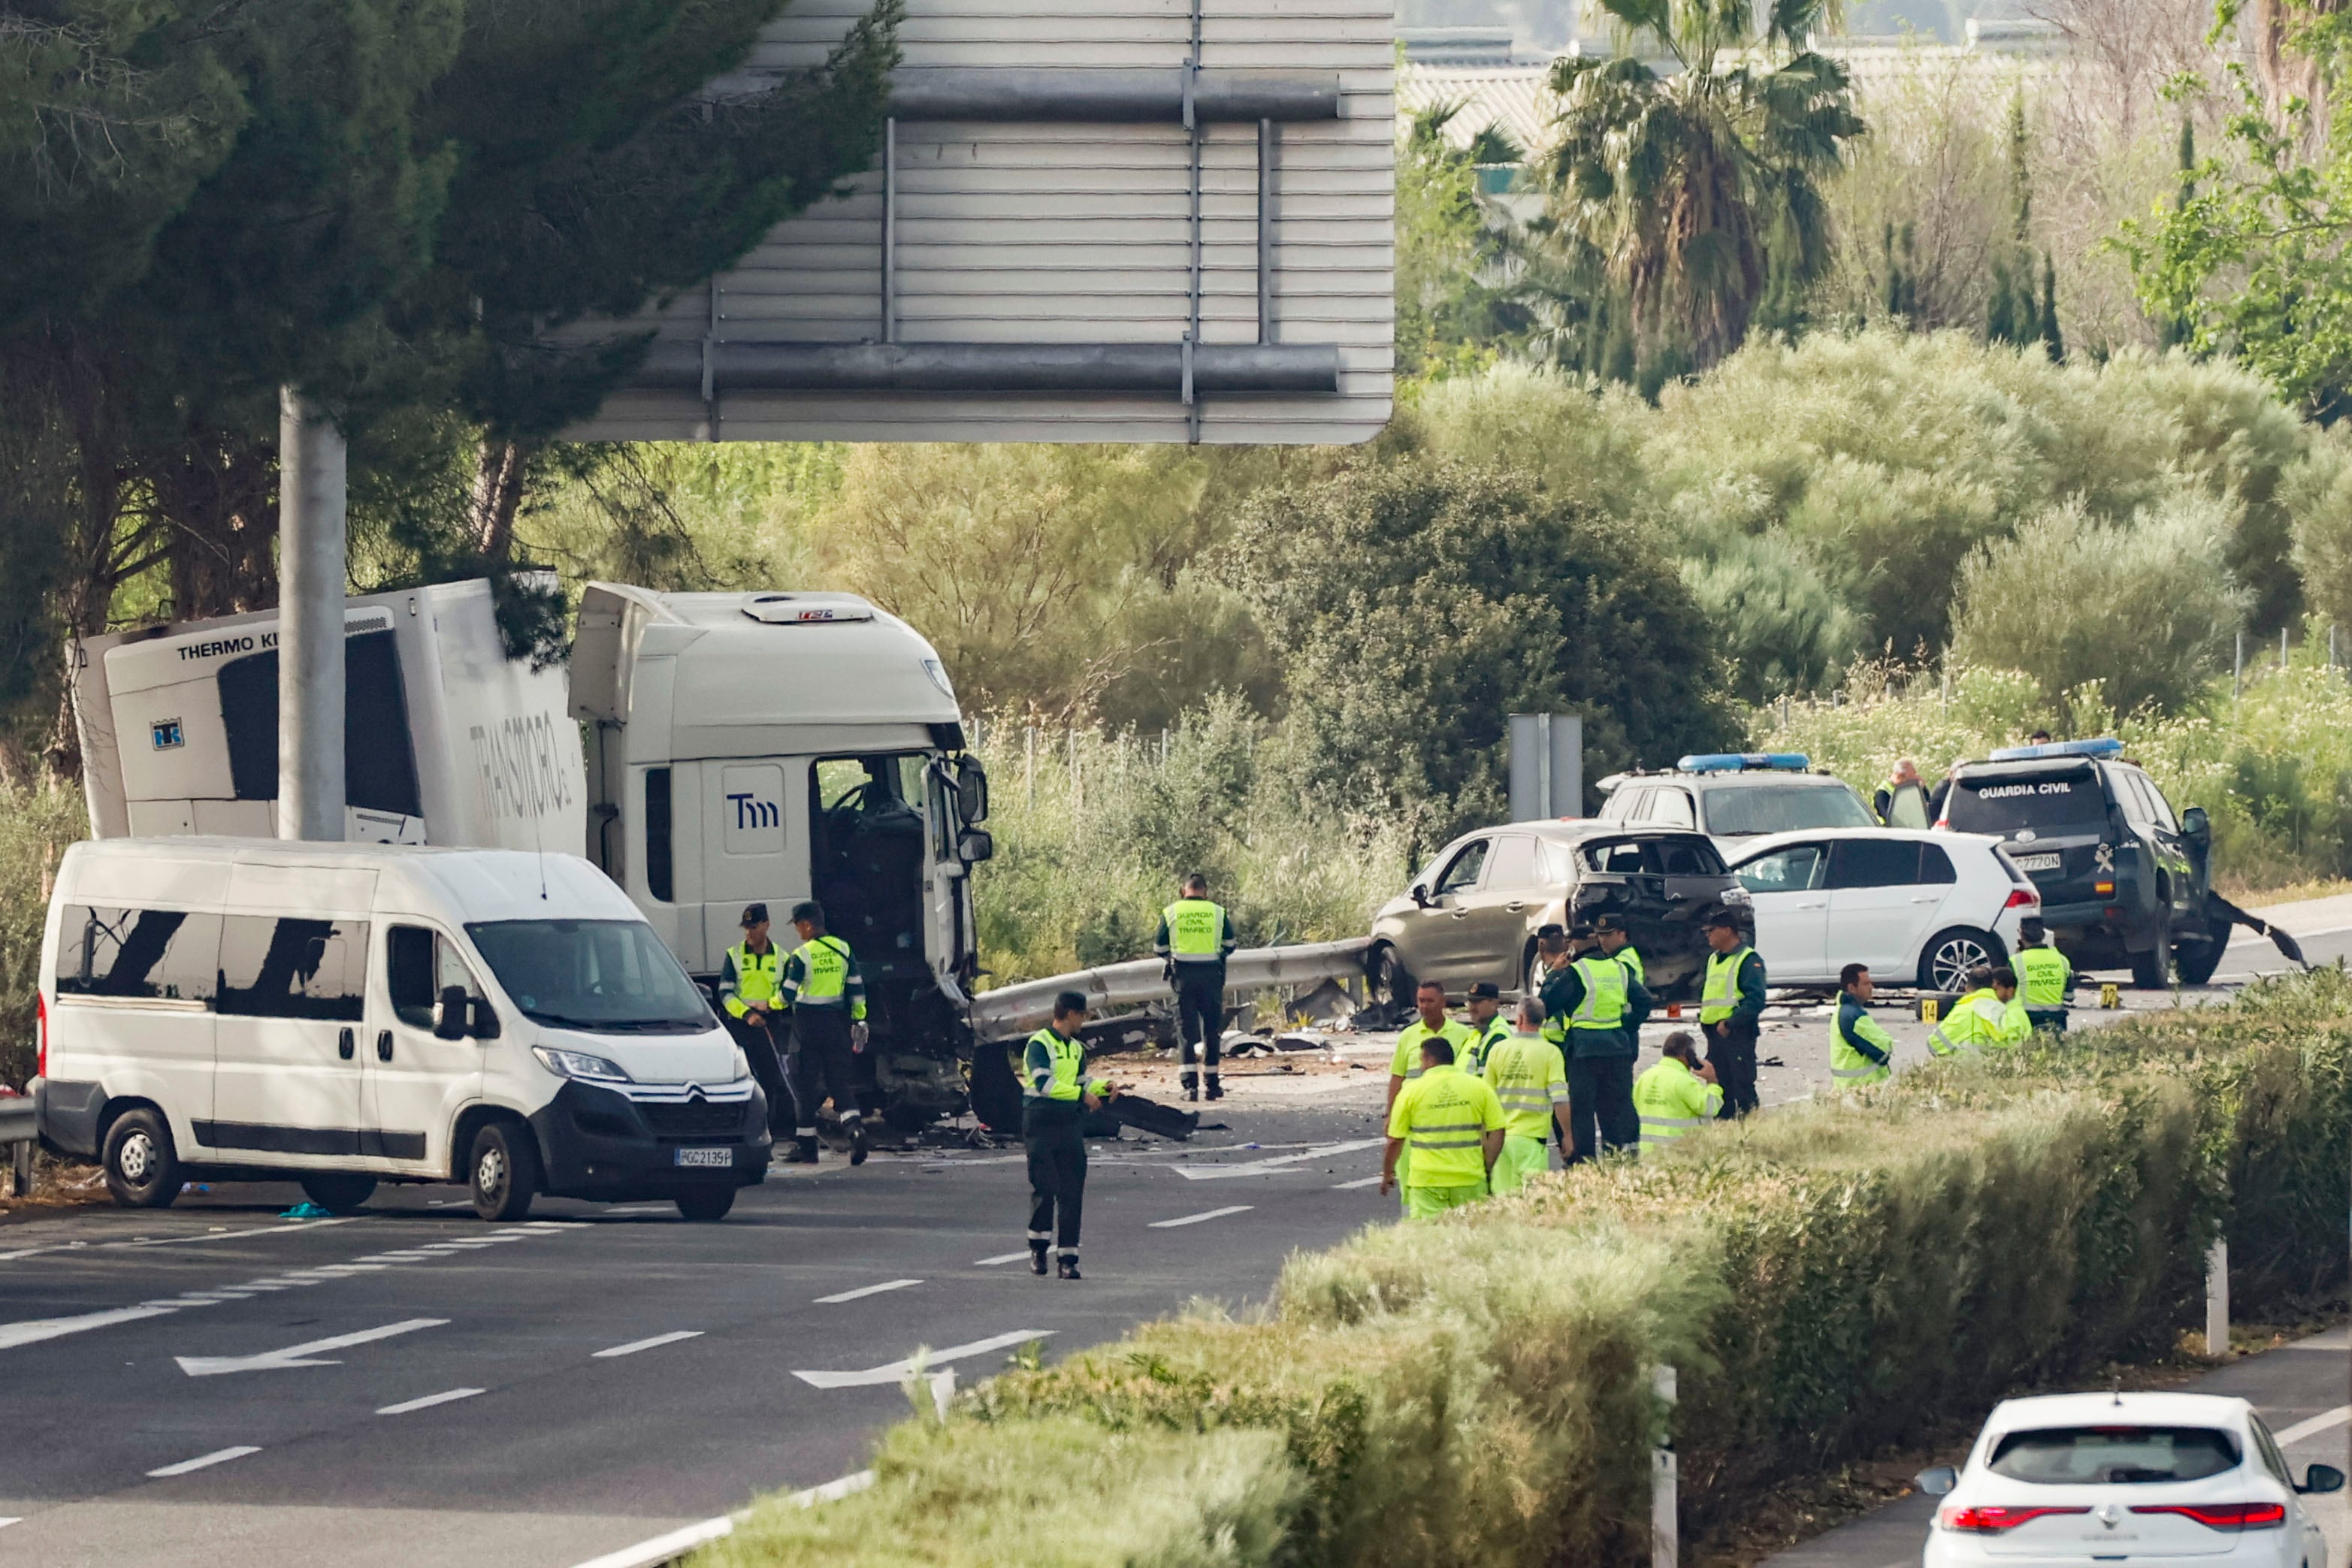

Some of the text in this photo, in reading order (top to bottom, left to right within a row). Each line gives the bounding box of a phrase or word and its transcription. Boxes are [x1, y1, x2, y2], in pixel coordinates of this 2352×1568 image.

[177, 632, 279, 660] THERMO KI
[1979, 782, 2072, 799] GUARDIA CIVIL
[2103, 987, 2116, 1005] 12
[1924, 1003, 1935, 1020] 14
